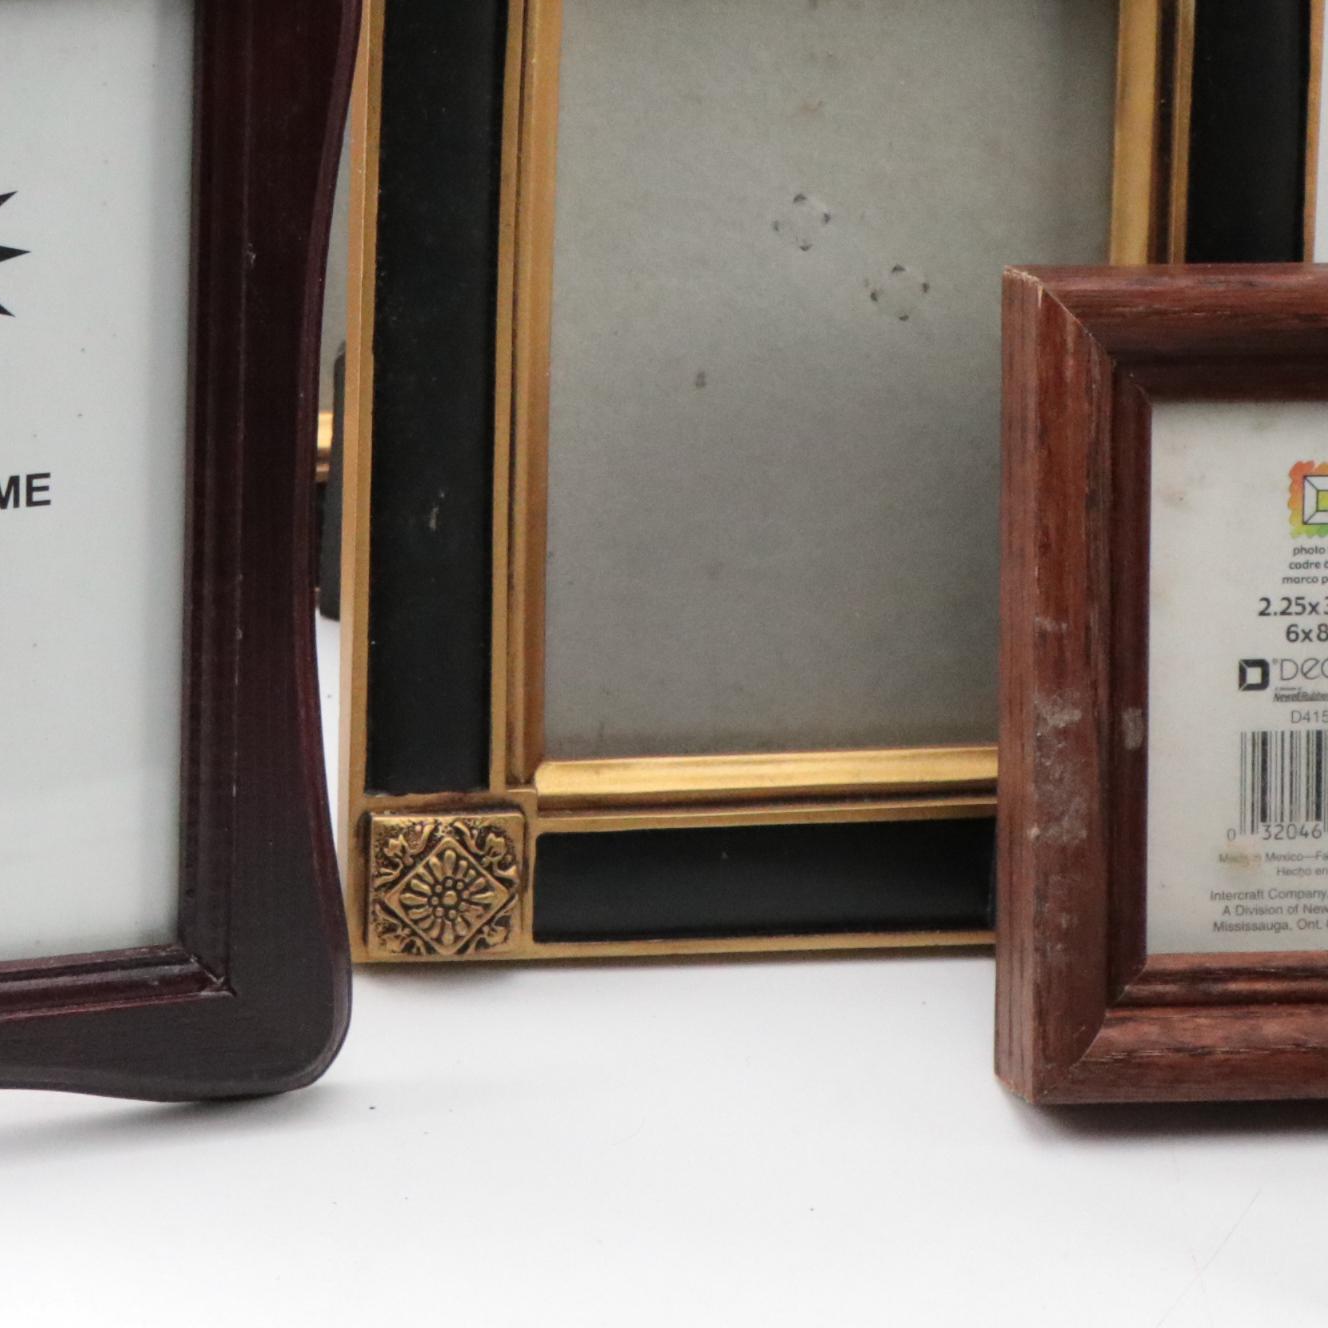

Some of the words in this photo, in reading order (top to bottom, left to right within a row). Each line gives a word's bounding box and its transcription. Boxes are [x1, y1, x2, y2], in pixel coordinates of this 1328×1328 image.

[1281, 576, 1319, 585] marco
[1290, 709, 1328, 724] D415
[1226, 828, 1237, 842] 0
[1262, 823, 1323, 841] 32046
[1209, 889, 1265, 902] Intercraft
[1222, 904, 1232, 917] A
[1235, 903, 1283, 916] Division
[1287, 903, 1299, 915] of
[1302, 903, 1328, 915] New
